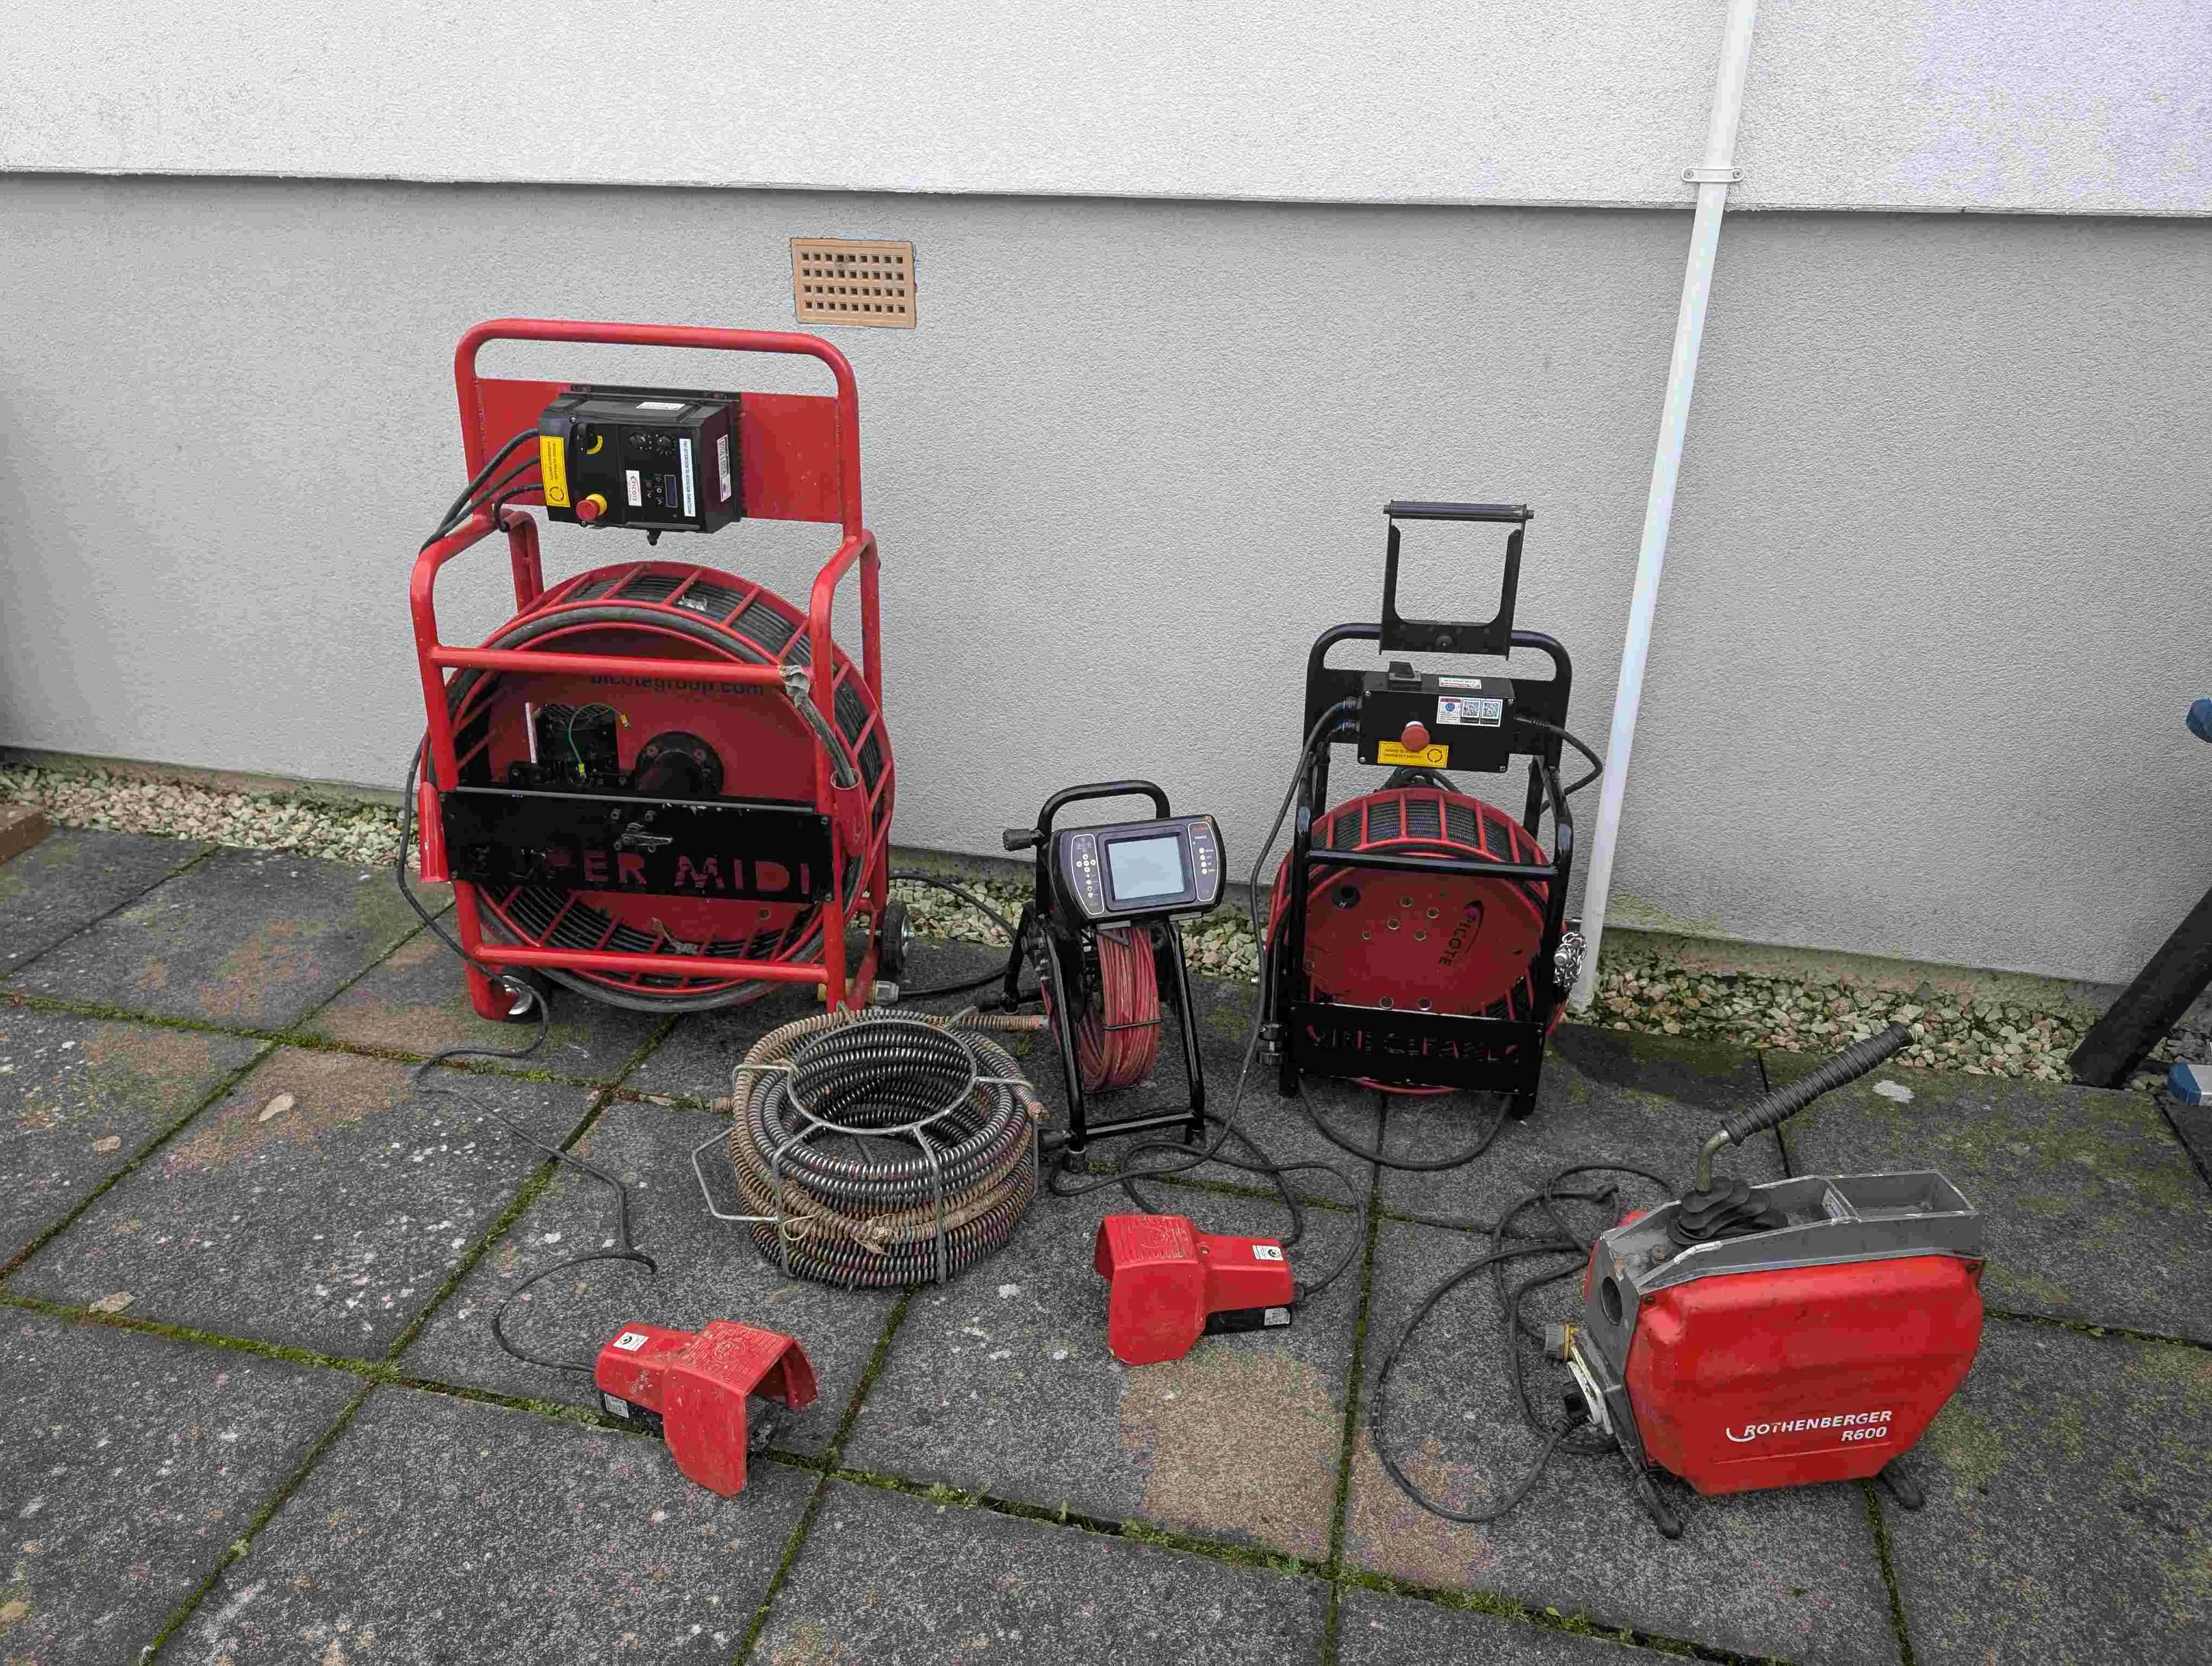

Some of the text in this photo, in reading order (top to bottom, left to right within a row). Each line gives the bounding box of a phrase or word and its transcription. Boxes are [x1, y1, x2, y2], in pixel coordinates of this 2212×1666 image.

[675, 854, 812, 894] MIDI
[1744, 1411, 1892, 1437] ROTHENBERGER
[1841, 1426, 1887, 1441] R600
